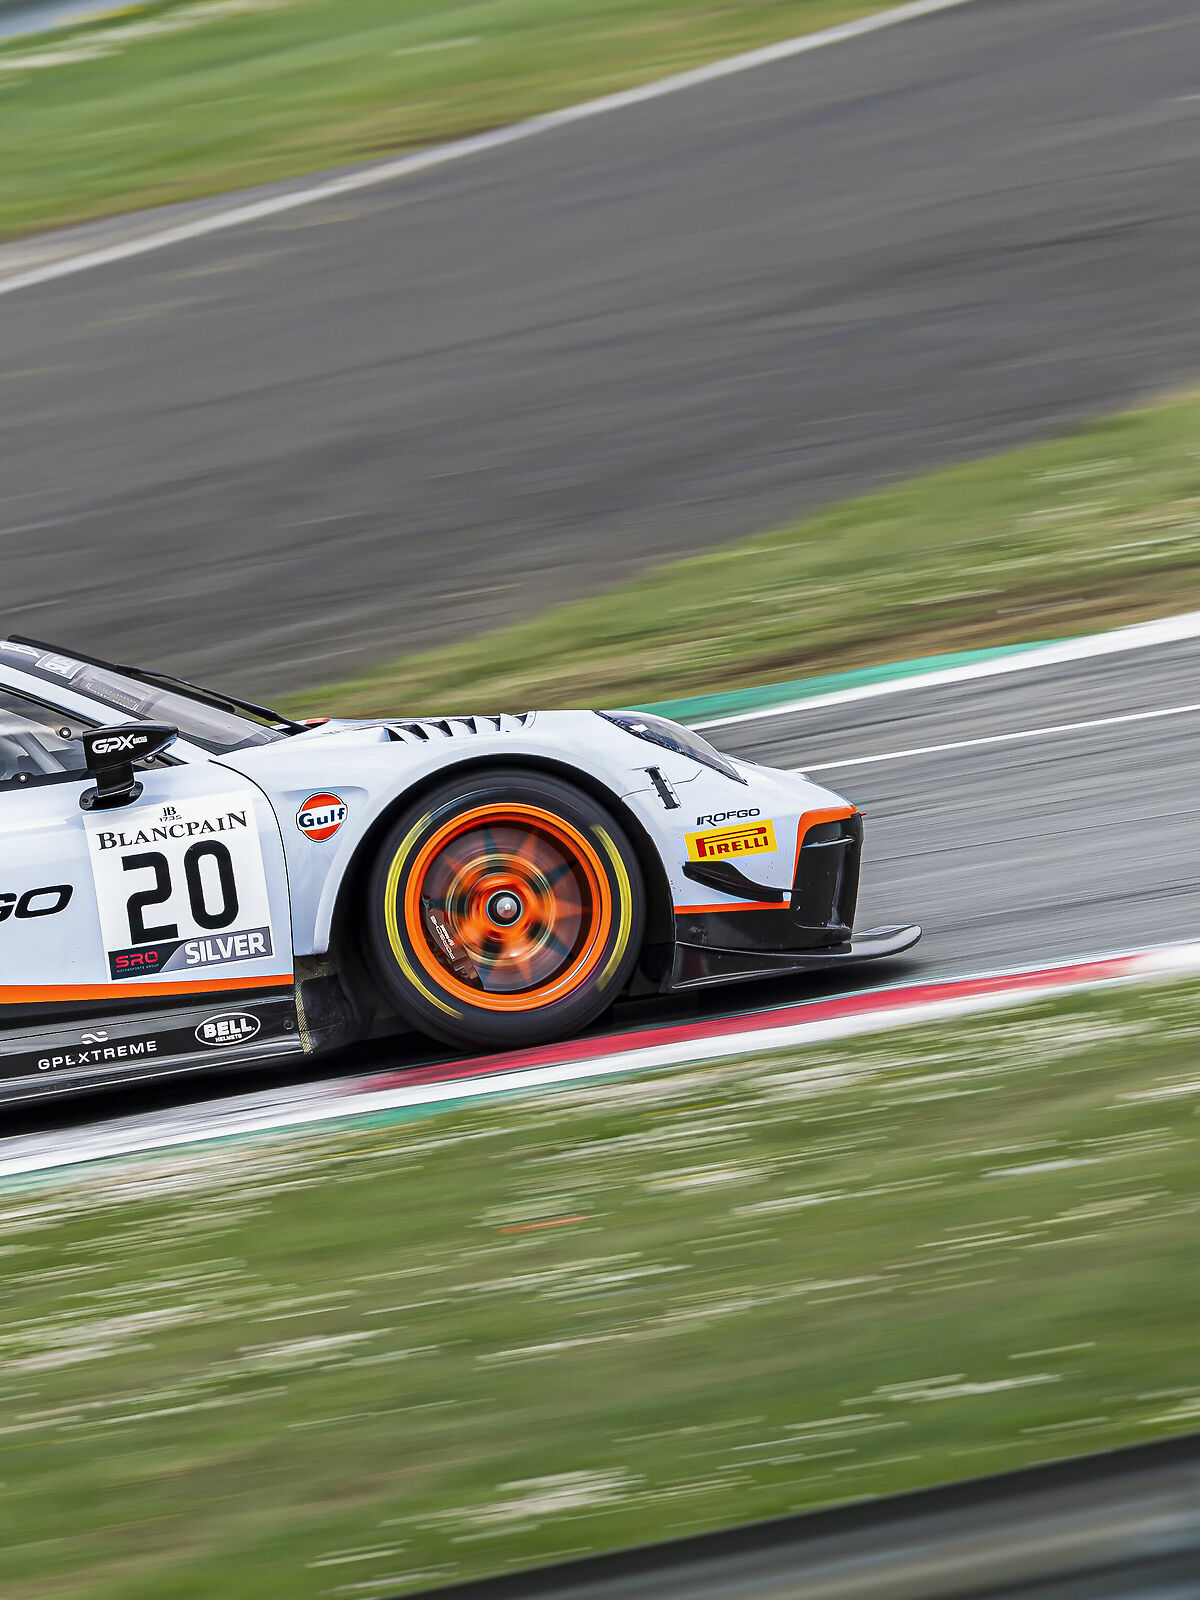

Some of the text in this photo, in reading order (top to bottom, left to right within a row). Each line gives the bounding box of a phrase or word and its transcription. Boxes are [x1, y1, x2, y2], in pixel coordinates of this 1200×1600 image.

[91, 734, 135, 754] GPX
[299, 807, 345, 828] Gulf
[696, 827, 769, 858] PIRELLI
[121, 840, 239, 945] 20
[115, 932, 267, 968] SRO SILVER
